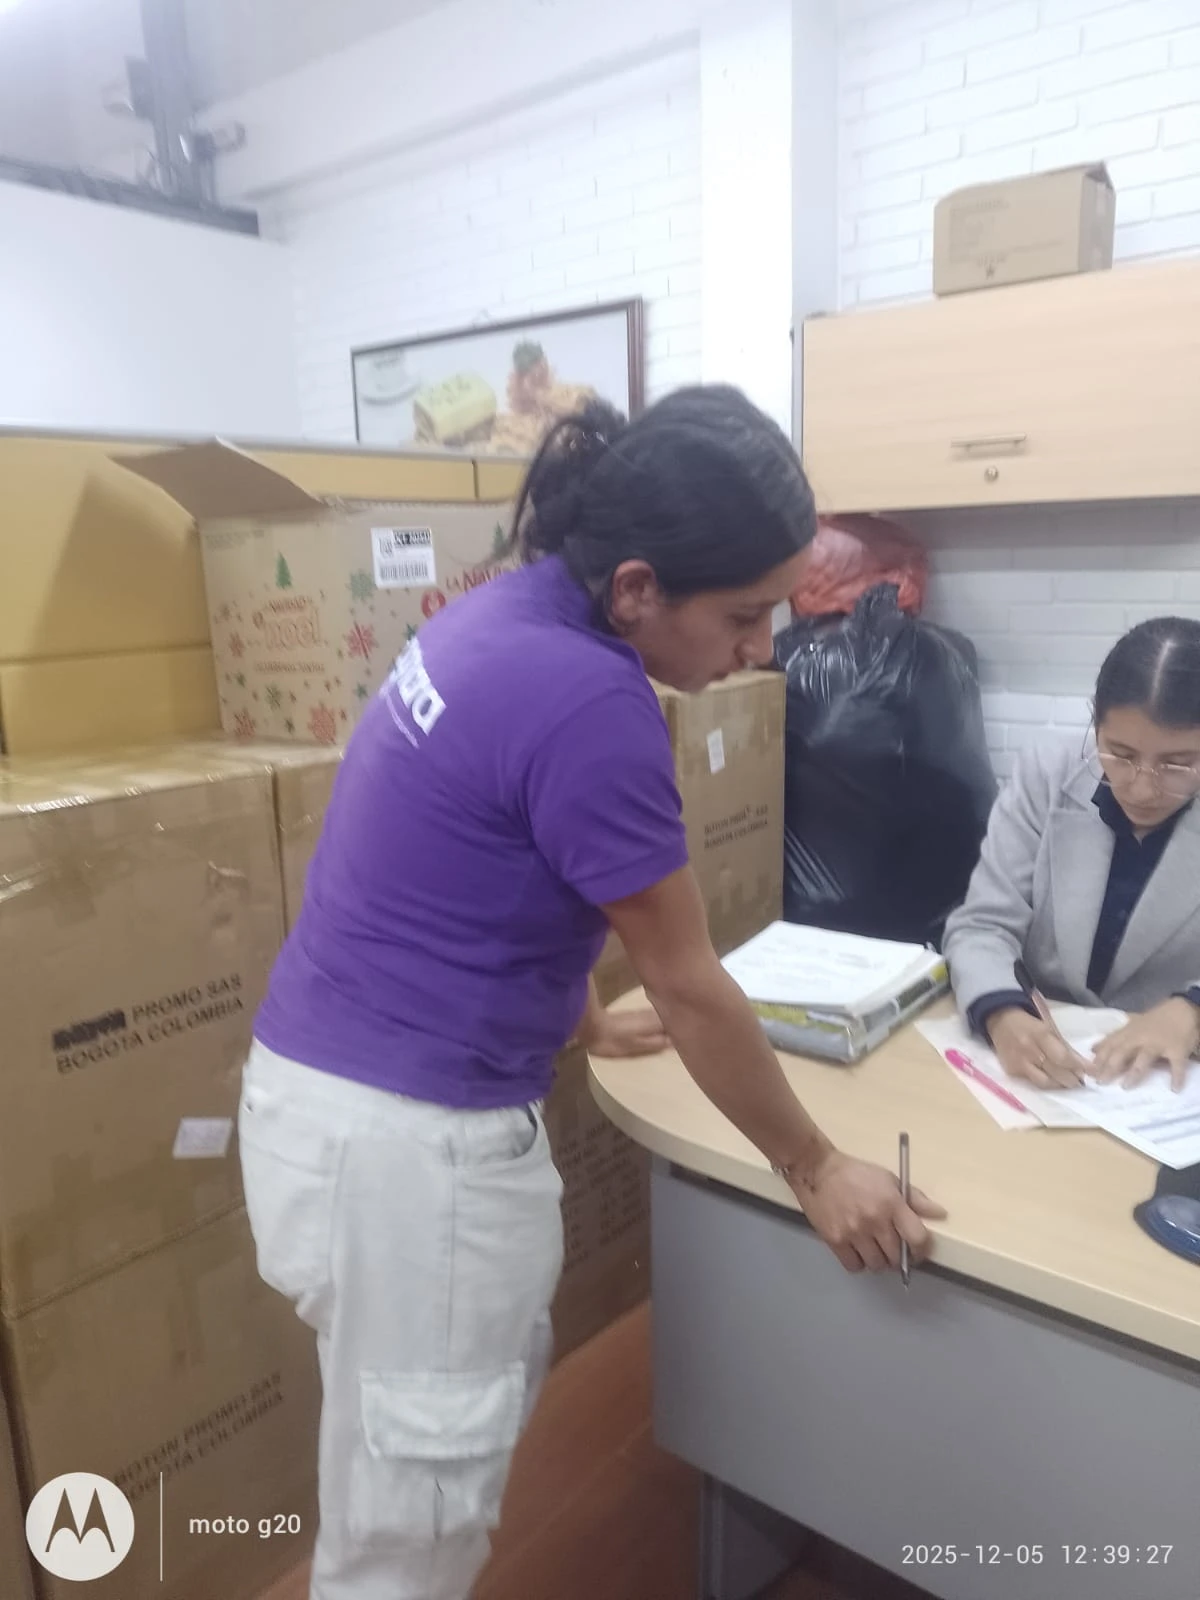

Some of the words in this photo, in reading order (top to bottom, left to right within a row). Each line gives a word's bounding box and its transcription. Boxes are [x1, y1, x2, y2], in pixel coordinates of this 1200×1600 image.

[132, 985, 202, 1024] PROMO
[207, 972, 242, 999] SAS
[56, 1030, 143, 1075] BOGOTA
[148, 996, 244, 1043] COLOMBIA
